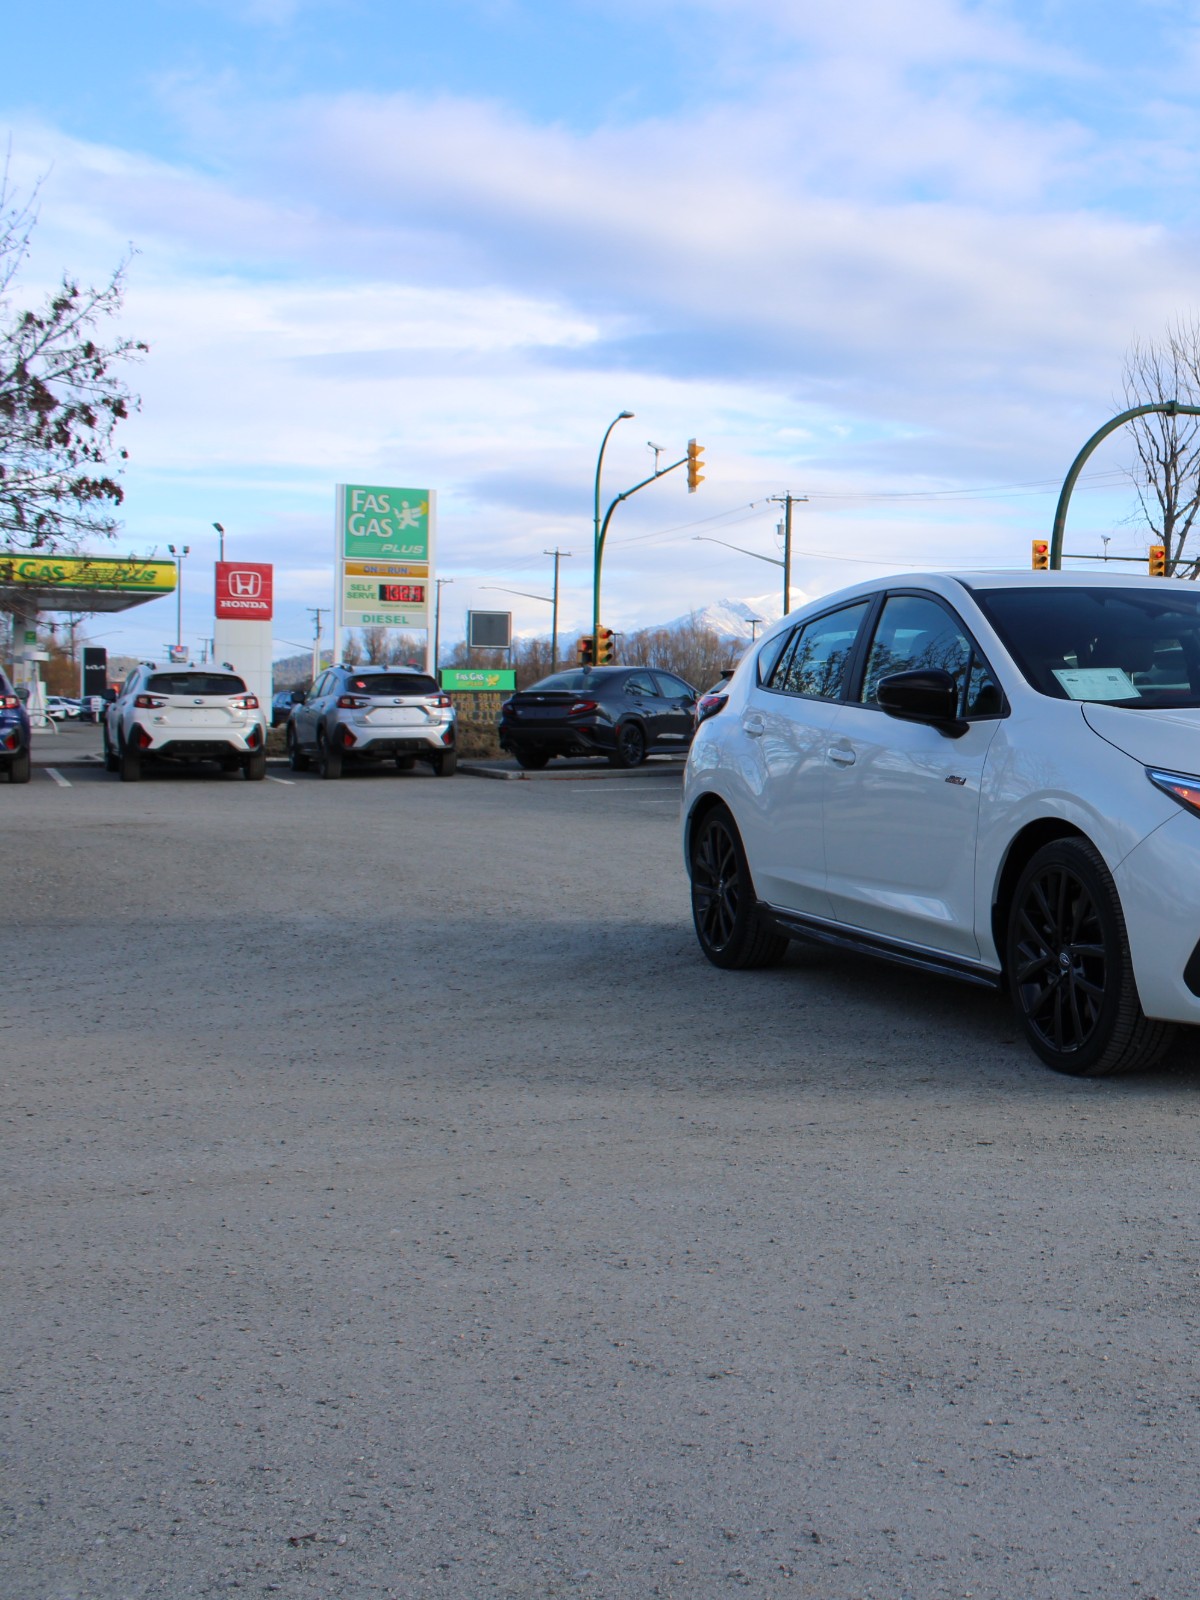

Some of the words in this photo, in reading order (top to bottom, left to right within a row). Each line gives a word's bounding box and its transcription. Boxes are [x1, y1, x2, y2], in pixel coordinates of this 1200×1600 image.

[351, 489, 391, 514] FAS
[348, 513, 393, 538] GAS
[381, 544, 424, 554] PLUS
[18, 561, 65, 580] GAS
[346, 592, 377, 600] SERVE
[220, 600, 269, 609] HONDA
[362, 614, 409, 625] DIESEL
